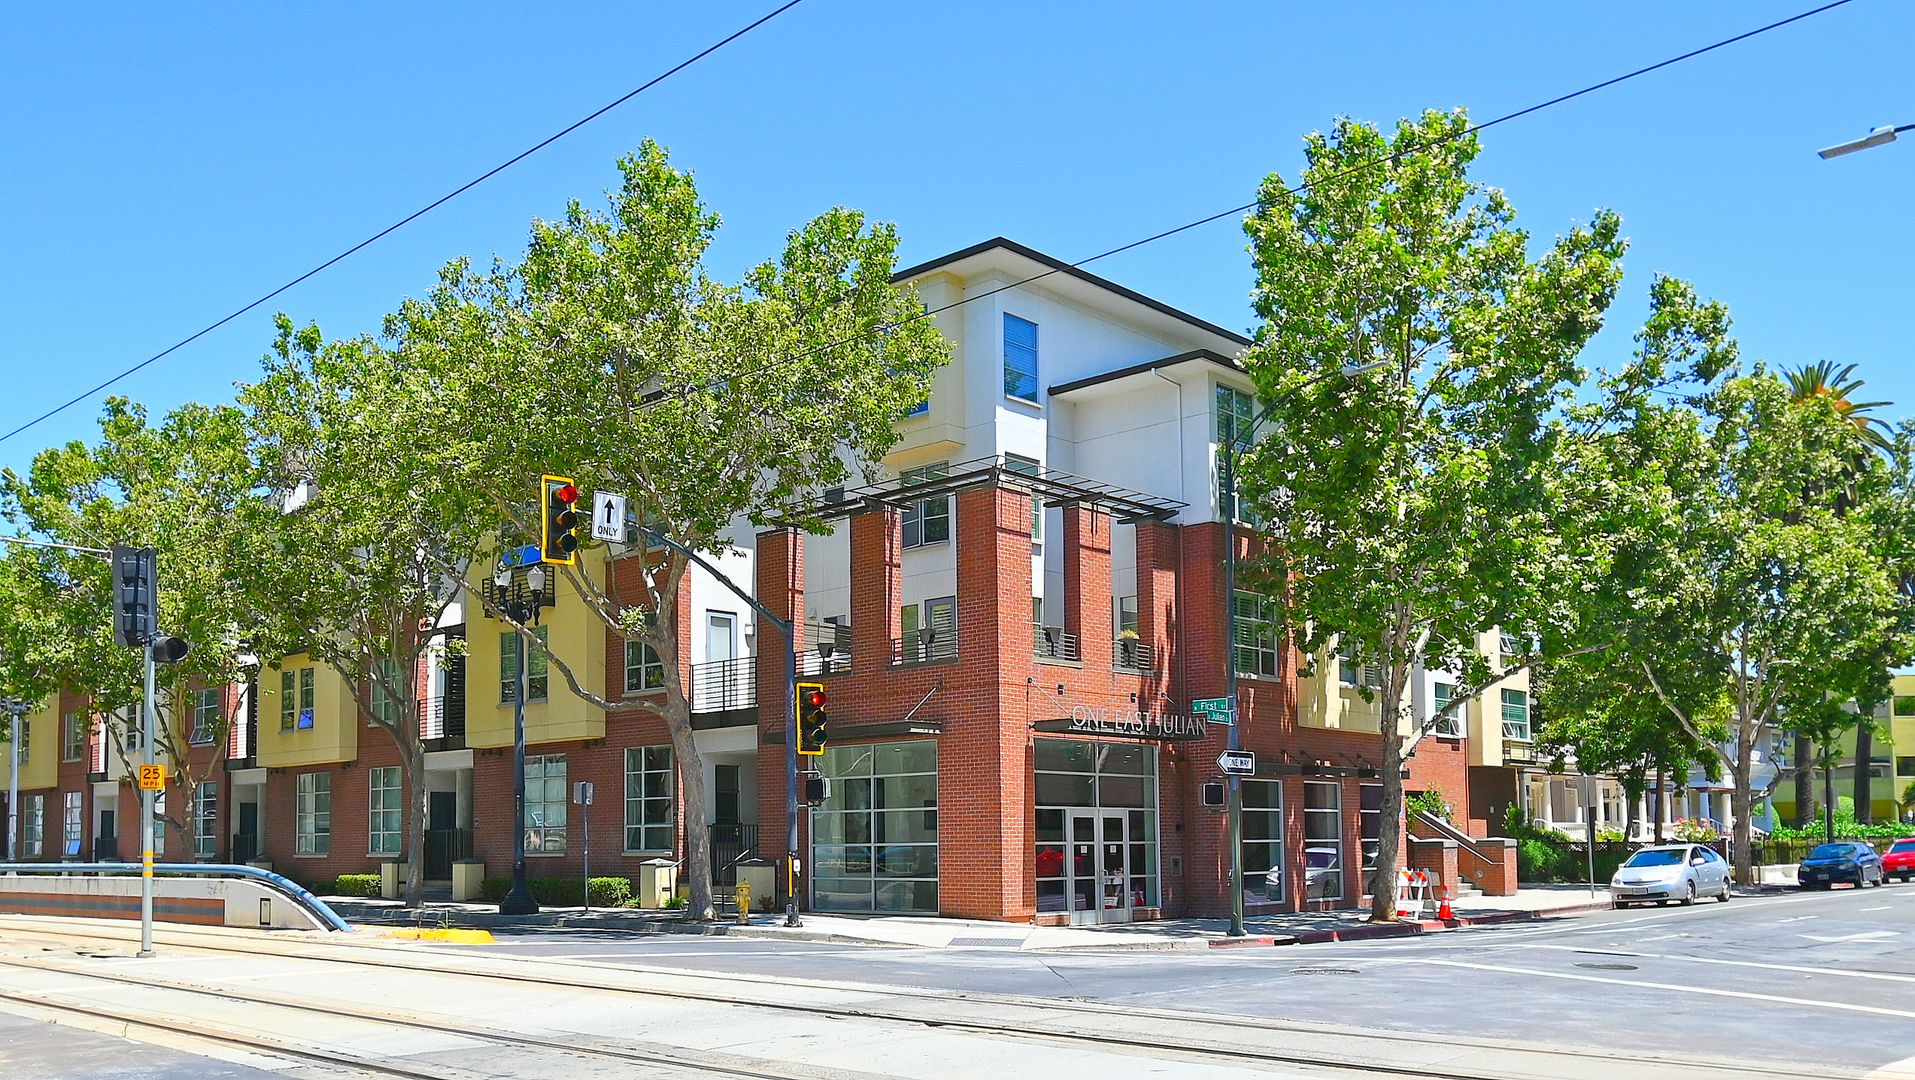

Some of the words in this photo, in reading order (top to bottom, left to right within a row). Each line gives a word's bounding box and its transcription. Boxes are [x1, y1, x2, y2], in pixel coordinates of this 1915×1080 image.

[597, 525, 618, 536] ONLY
[1200, 701, 1217, 710] First
[1072, 705, 1108, 728] ONE
[1115, 709, 1151, 732] EAST
[1157, 714, 1207, 736] JULIAN
[143, 768, 160, 779] 25
